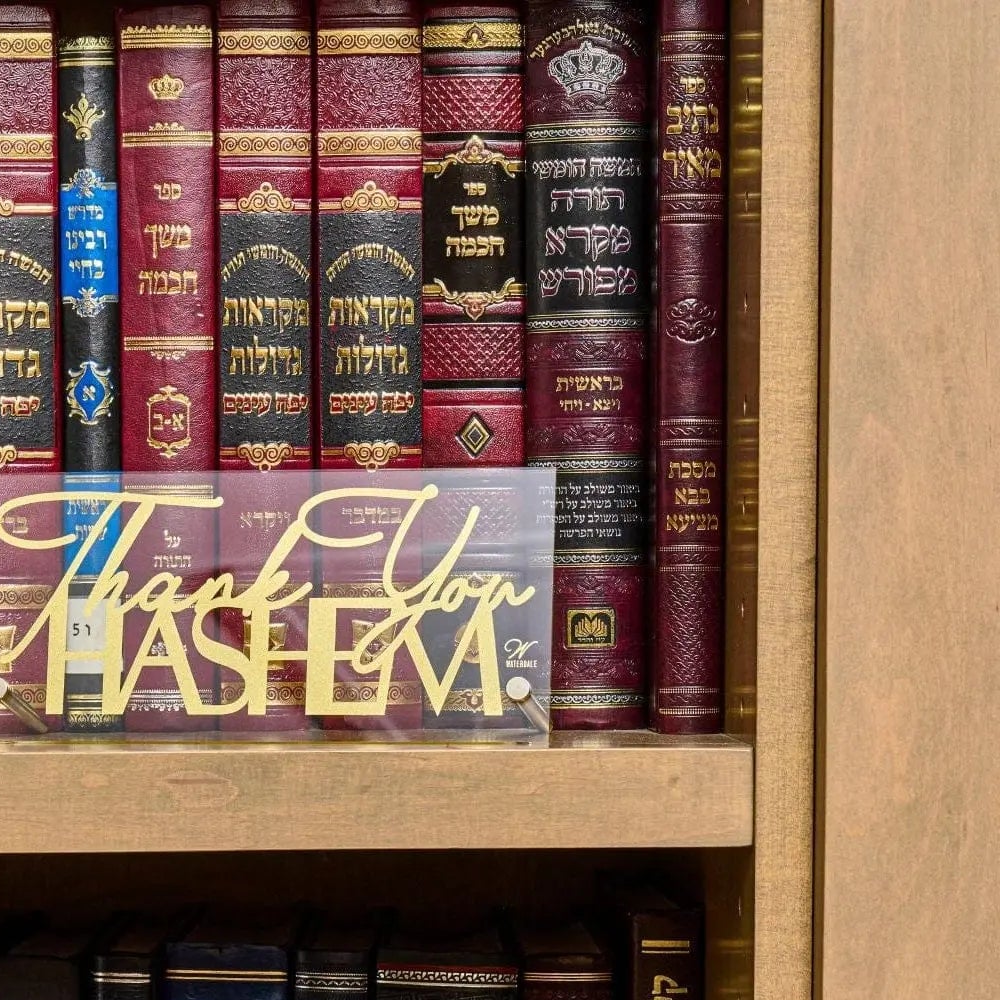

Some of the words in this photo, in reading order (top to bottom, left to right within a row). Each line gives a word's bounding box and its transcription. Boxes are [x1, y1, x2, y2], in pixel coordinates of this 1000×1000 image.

[680, 75, 705, 94] ספר
[666, 103, 718, 136] נתיב
[663, 148, 721, 179] מאיר
[154, 184, 182, 200] ספר
[463, 182, 487, 196] ספר
[551, 187, 625, 212] תורה
[452, 205, 499, 231] משך
[66, 230, 107, 250] רבינו
[145, 224, 192, 259] משך
[446, 236, 504, 258] חכמה
[545, 224, 632, 262] מקרא
[9, 251, 52, 286] חמשה
[69, 260, 105, 279] בחיי
[139, 270, 198, 295] חכמה
[538, 266, 637, 298] מפורש
[222, 295, 309, 333] מקראות
[328, 295, 415, 332] מקראות
[230, 335, 303, 375] גדולות
[335, 334, 410, 375] גדולות
[82, 386, 96, 401] א
[556, 374, 623, 392] בראשית
[0, 397, 41, 418] יפה
[223, 393, 272, 417] עינים
[275, 393, 309, 415] יפה
[329, 393, 378, 416] עינים
[381, 392, 415, 414] יפה
[668, 460, 716, 480] מסכת
[674, 487, 711, 505] בבא
[665, 513, 719, 533] מציעא
[164, 530, 181, 548] על
[154, 555, 191, 568] התורה
[301, 484, 535, 674] You
[45, 596, 503, 717] HASHEM
